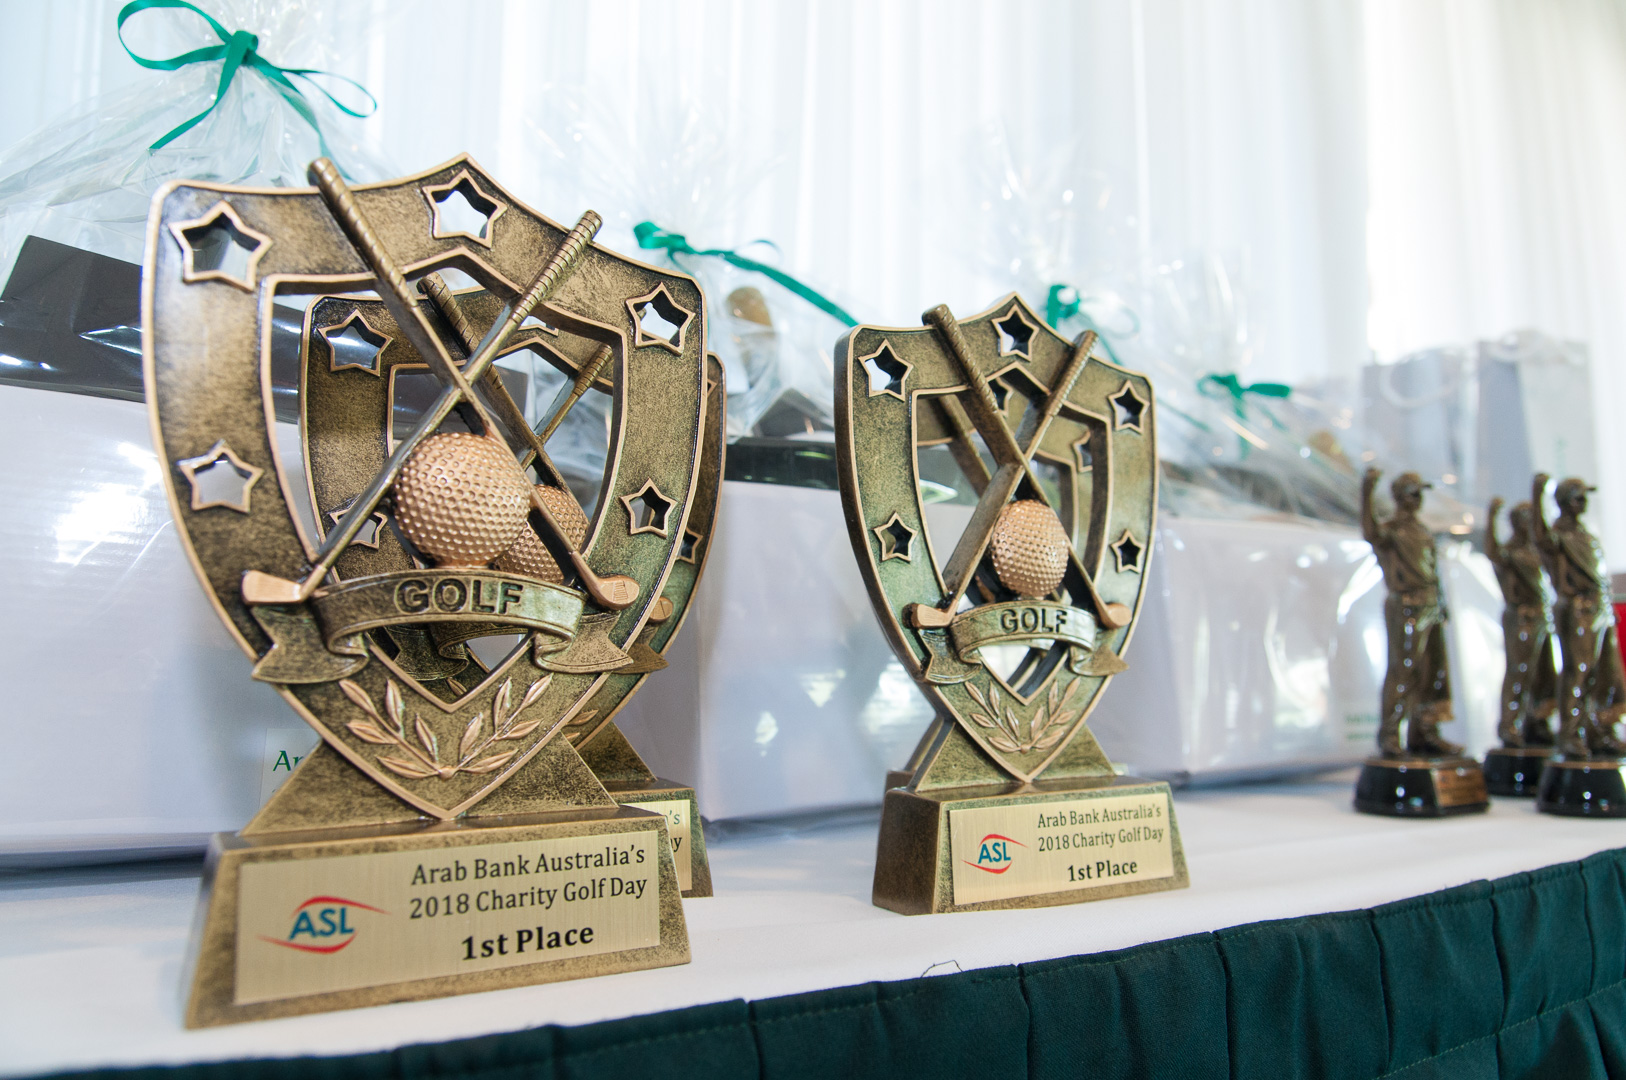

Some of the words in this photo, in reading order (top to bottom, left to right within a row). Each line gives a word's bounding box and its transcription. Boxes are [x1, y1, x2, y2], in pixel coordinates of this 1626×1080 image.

[394, 578, 524, 615] GOLF
[1001, 608, 1067, 634] GOLF
[1038, 811, 1067, 828] Arab
[1069, 808, 1100, 825] Bank
[1102, 804, 1162, 822] Australia's
[977, 842, 1012, 865] ASL
[1038, 834, 1070, 852] 2018
[1072, 831, 1116, 848] Charity
[1118, 826, 1142, 843] Golf
[1143, 826, 1164, 842] Day
[411, 860, 467, 886] Arab
[474, 854, 530, 880] Bank
[1067, 864, 1093, 882] 1st
[1096, 860, 1138, 878] Place
[409, 892, 470, 919] 2018
[475, 886, 558, 913] Charity
[563, 878, 607, 902] Golf
[610, 876, 648, 899] Day
[288, 907, 355, 941] ASL
[462, 933, 509, 961] 1st
[515, 926, 594, 953] Place
